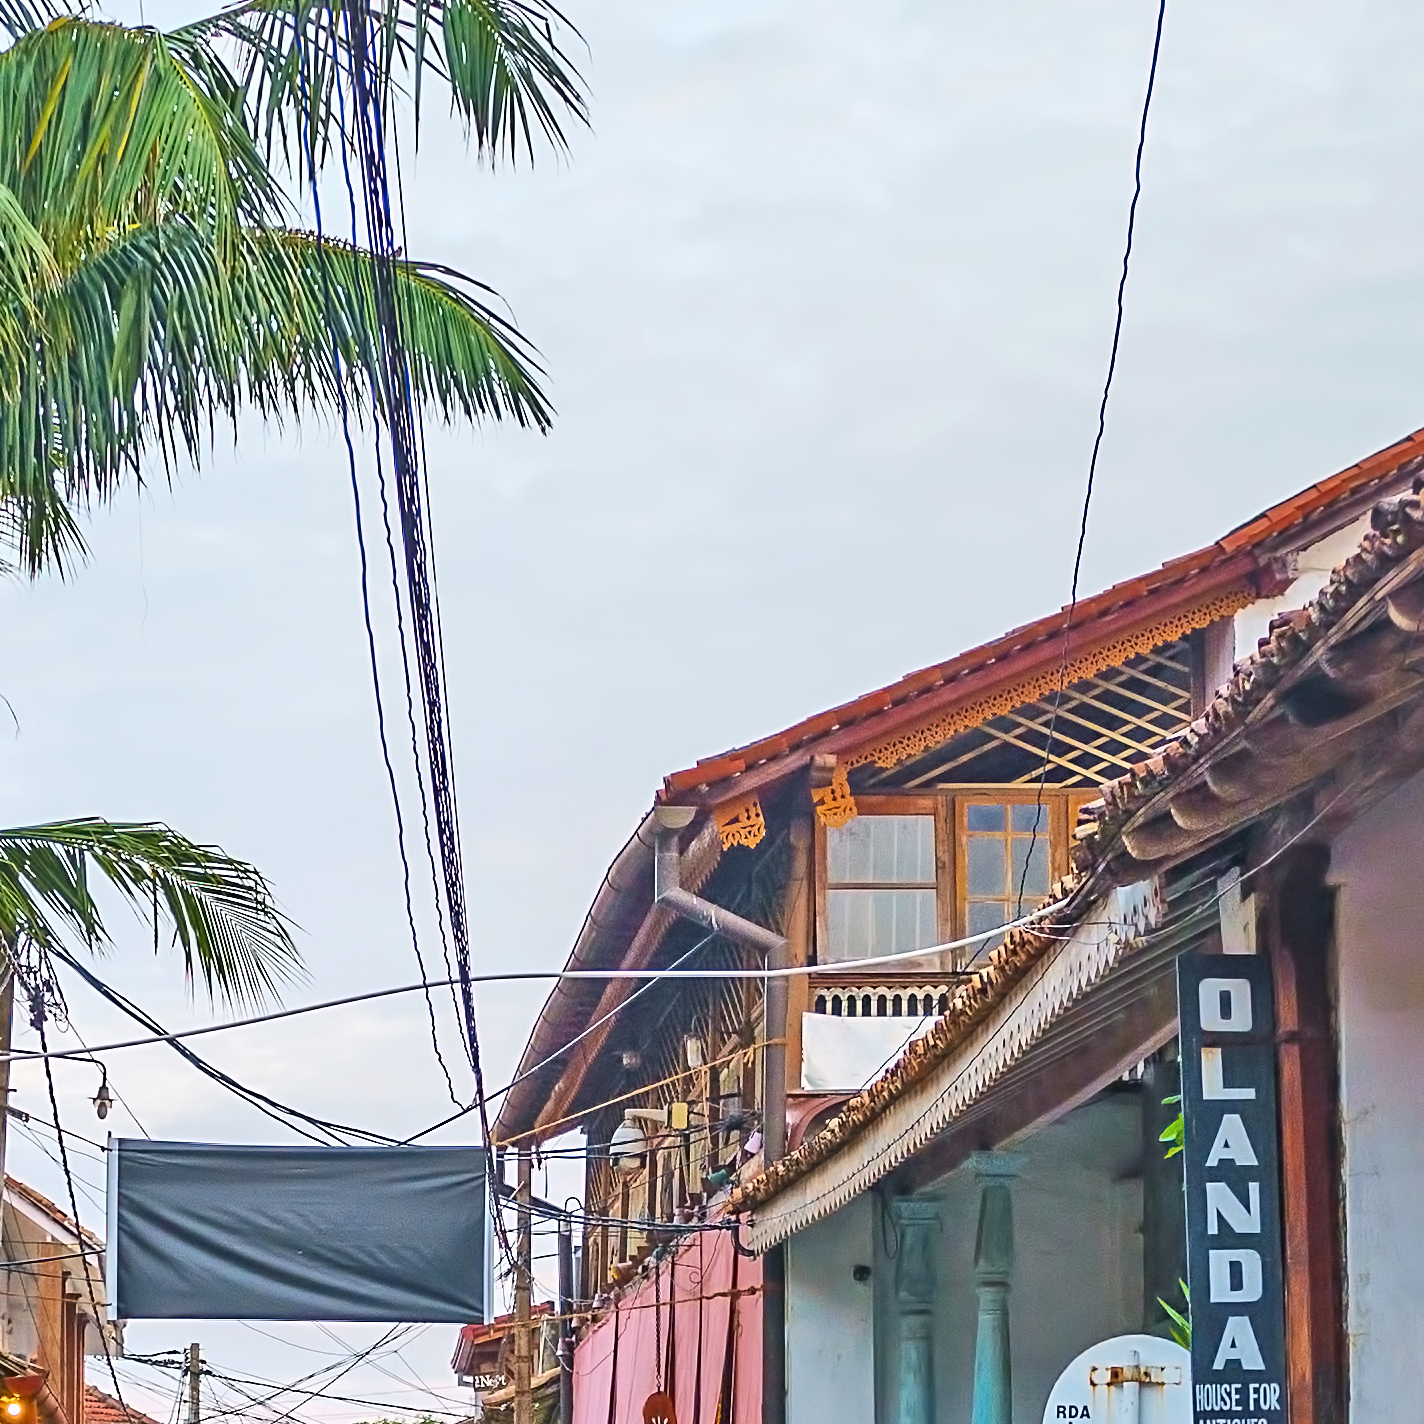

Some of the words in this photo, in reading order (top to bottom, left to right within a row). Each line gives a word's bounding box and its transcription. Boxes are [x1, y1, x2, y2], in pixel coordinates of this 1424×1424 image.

[1198, 978, 1266, 1371] OLANDA
[1195, 1383, 1243, 1411] HOUSE
[1249, 1383, 1281, 1411] FOR
[1056, 1405, 1091, 1419] RDA
